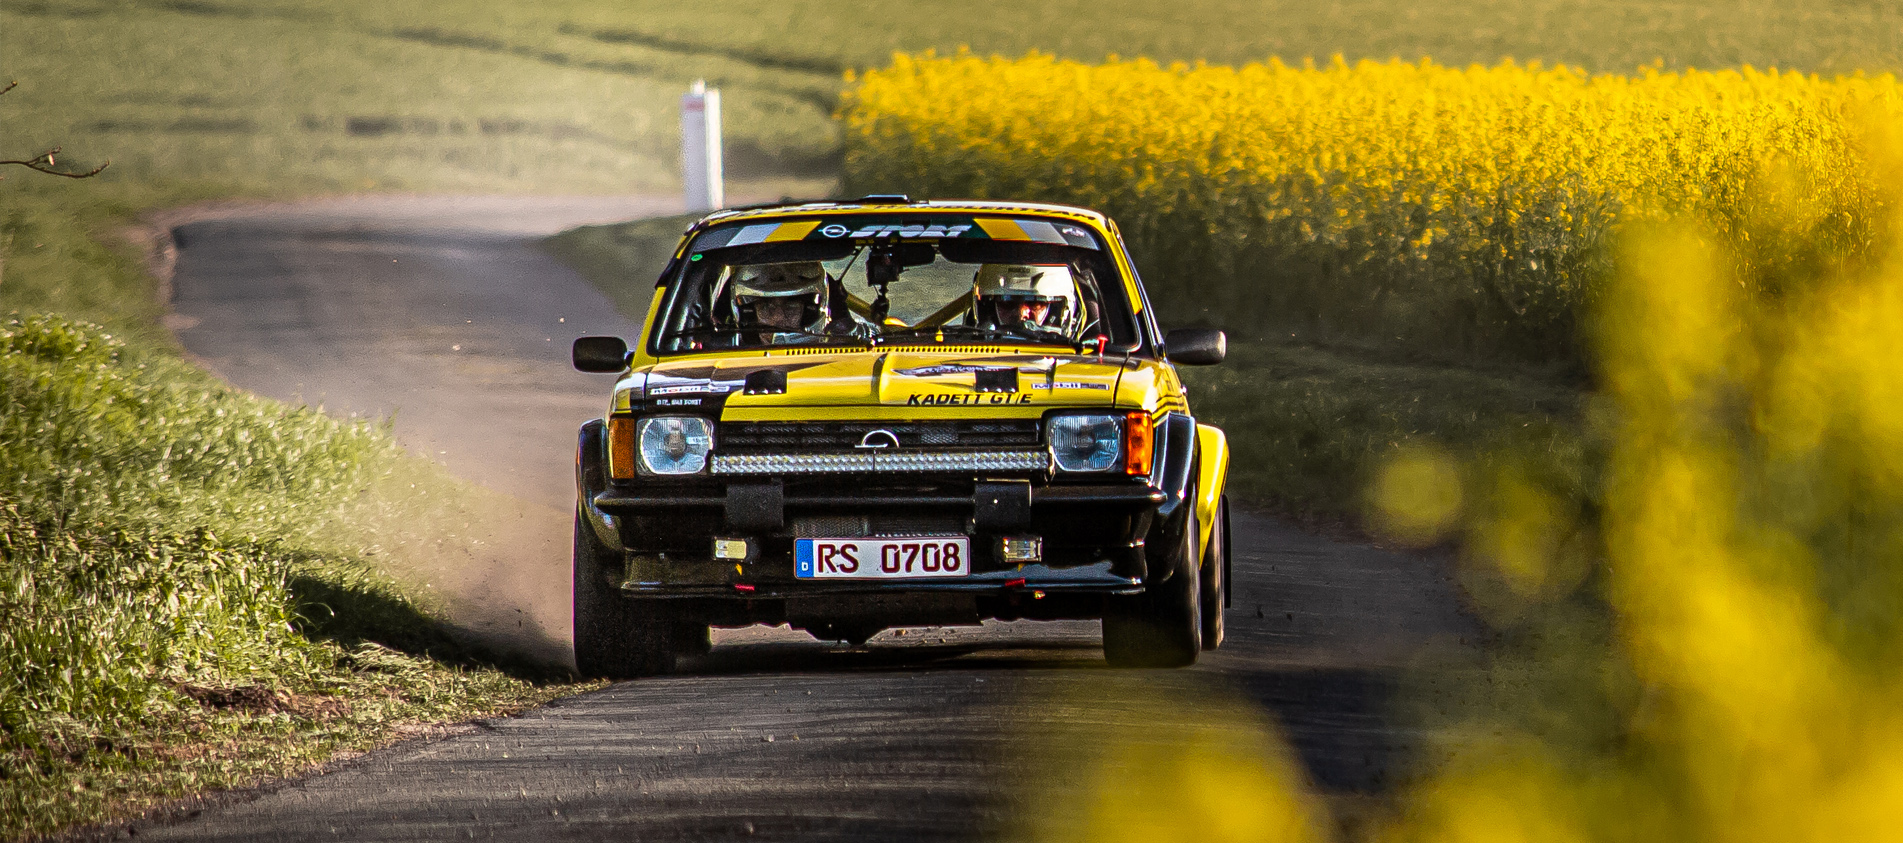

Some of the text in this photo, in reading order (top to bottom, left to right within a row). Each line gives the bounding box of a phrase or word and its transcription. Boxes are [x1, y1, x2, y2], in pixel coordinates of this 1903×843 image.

[849, 224, 973, 238] SPORT
[906, 393, 985, 406] KADETT
[817, 542, 961, 574] RS 0708
[801, 561, 809, 572] D
